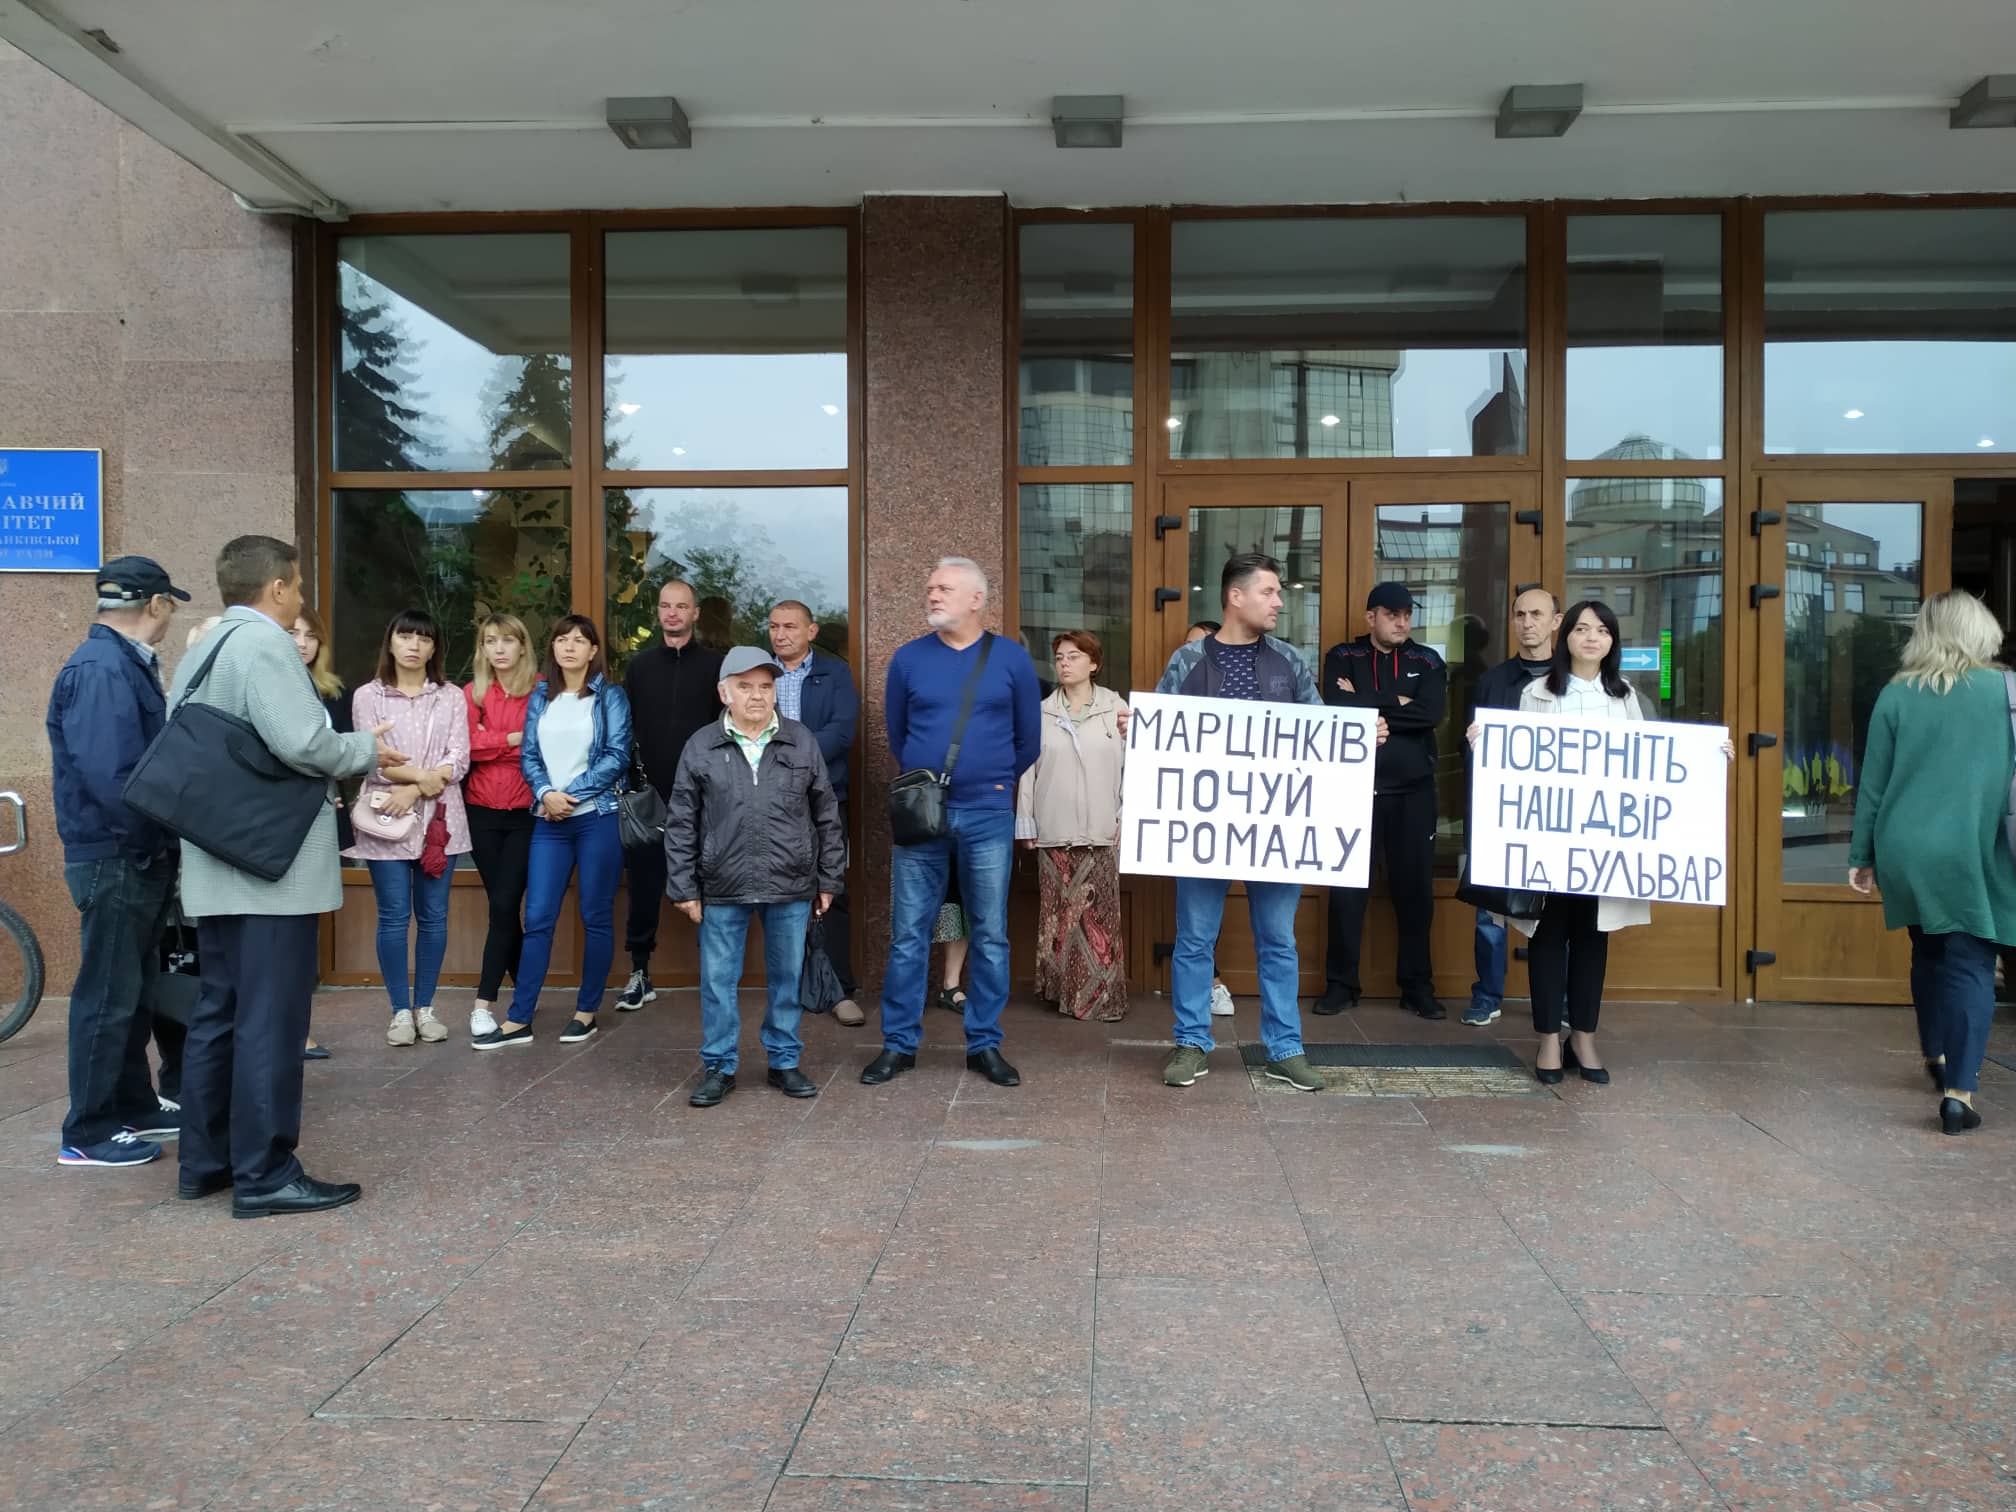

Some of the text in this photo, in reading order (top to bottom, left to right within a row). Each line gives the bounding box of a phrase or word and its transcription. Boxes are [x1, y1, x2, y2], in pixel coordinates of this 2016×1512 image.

[1131, 708, 1368, 764] МАРЦІНКІВ
[1482, 723, 1688, 784] ПОВЕРНІТЬ
[1157, 767, 1313, 818] ПОЧУЙ
[1498, 783, 1672, 840] НАШ ДВІР
[1137, 818, 1362, 872] ГРОМАДУ
[1566, 847, 1722, 902] БУЛЬВАР
